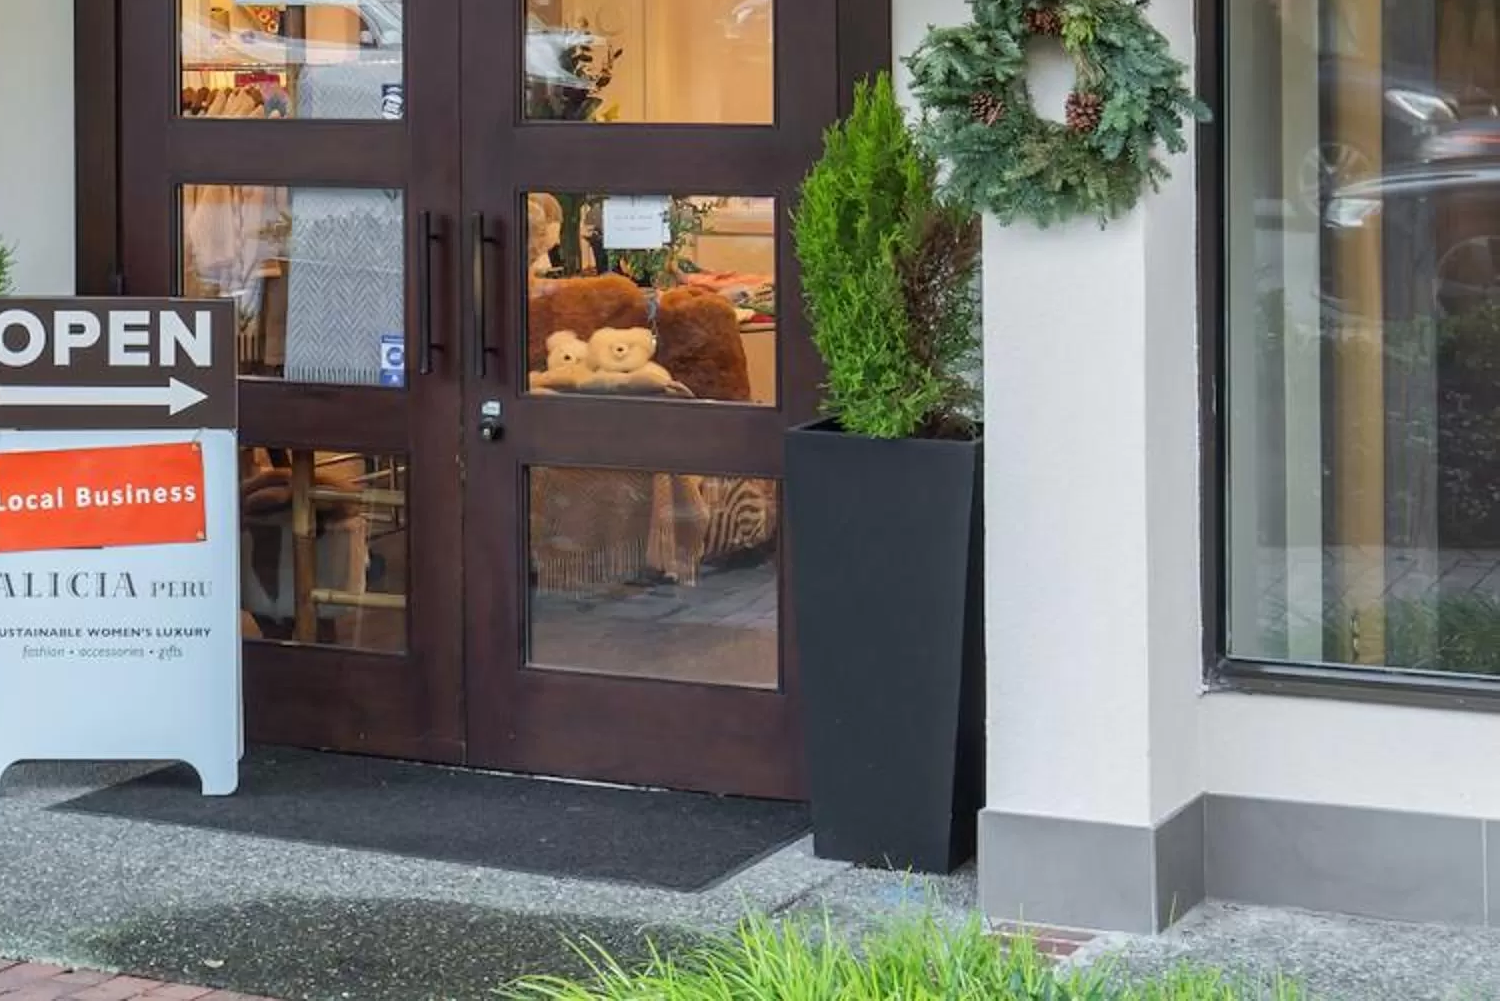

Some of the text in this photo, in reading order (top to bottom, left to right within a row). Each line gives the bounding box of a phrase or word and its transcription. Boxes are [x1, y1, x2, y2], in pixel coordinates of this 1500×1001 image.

[75, 483, 197, 509] Business
[150, 579, 213, 599] PERU
[87, 626, 151, 638] WOMEN'S
[155, 627, 212, 639] LUXURY
[22, 645, 65, 659] fashion
[79, 645, 145, 659] accessories
